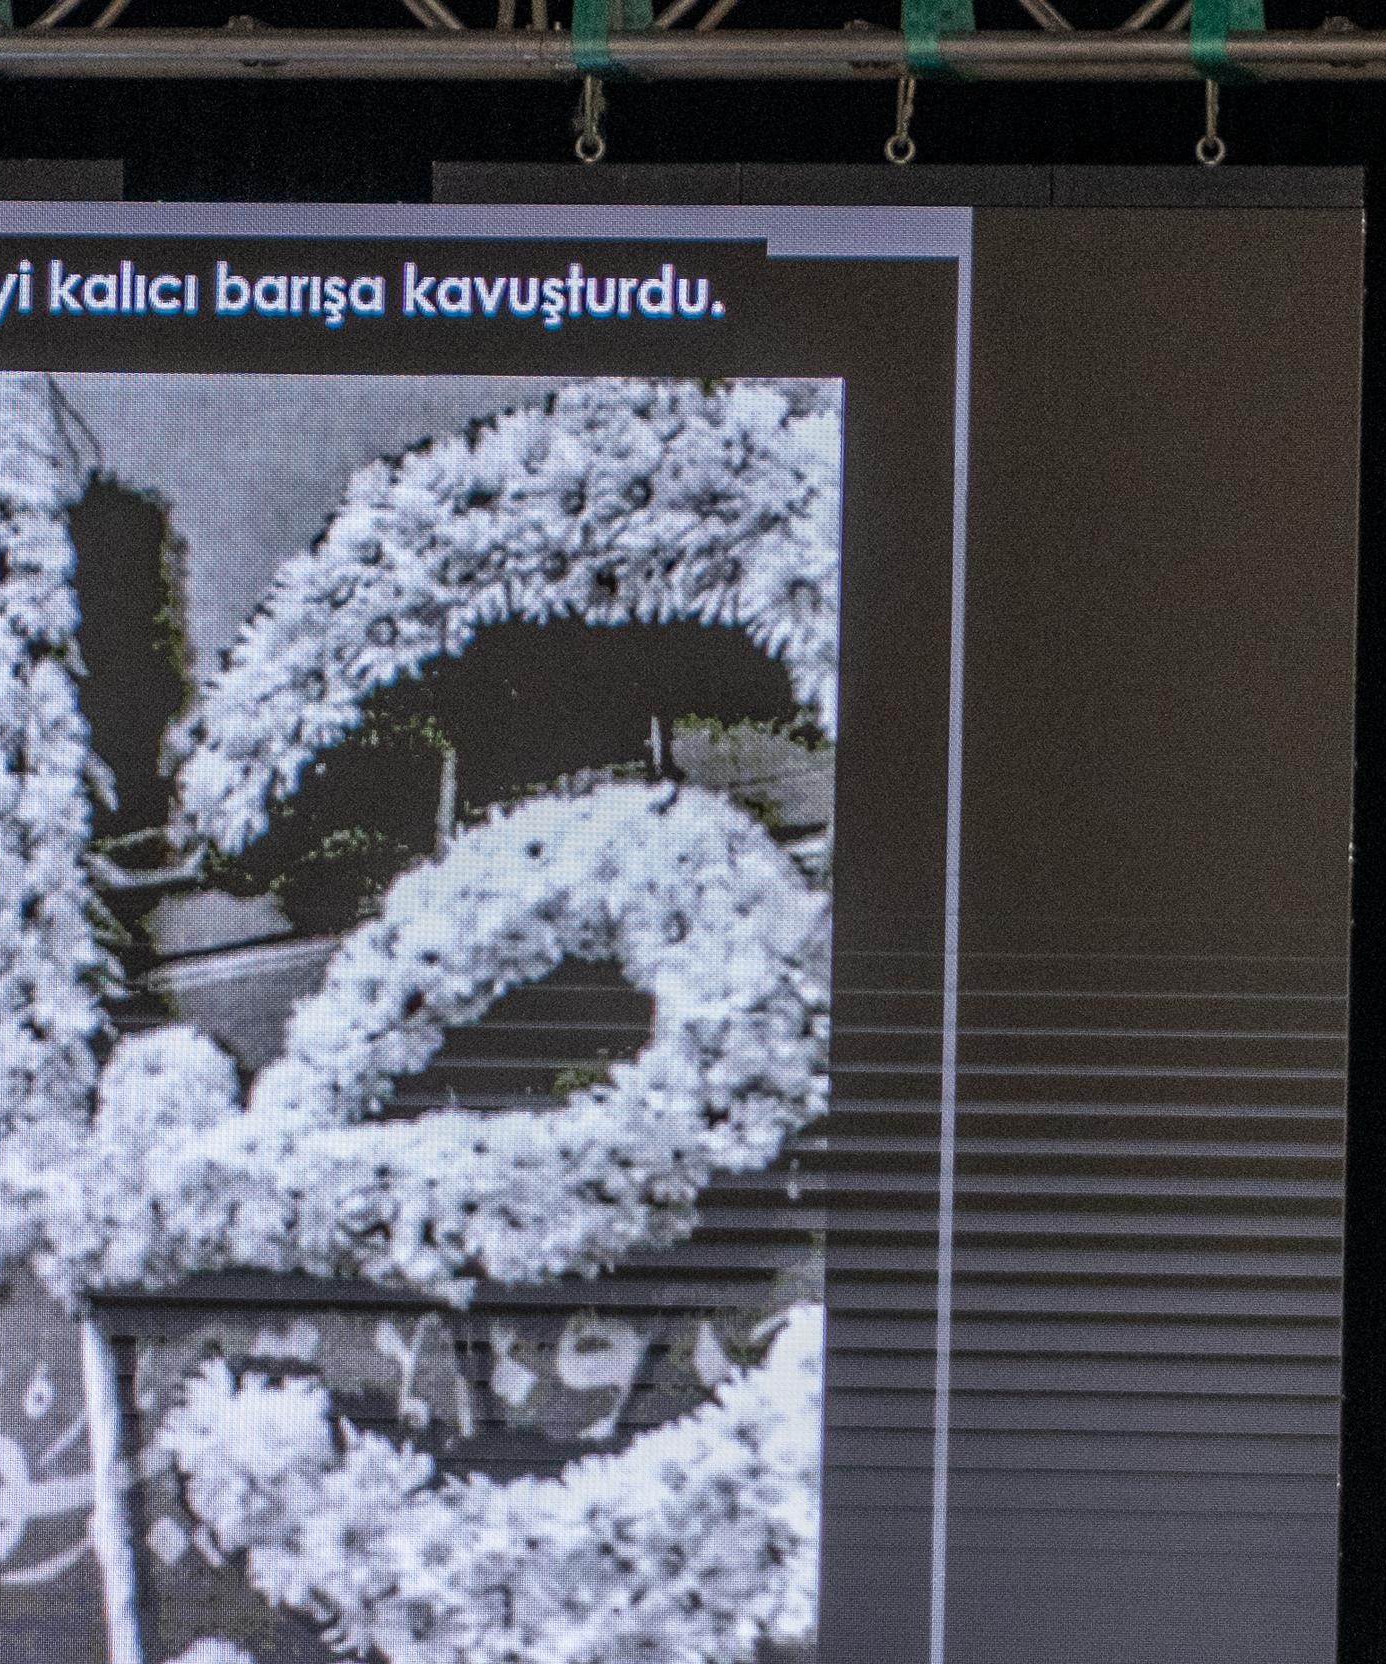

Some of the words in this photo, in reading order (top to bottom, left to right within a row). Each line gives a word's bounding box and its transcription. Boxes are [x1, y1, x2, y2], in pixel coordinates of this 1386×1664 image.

[47, 258, 200, 316] kalıcı
[214, 260, 386, 329] barışa
[401, 261, 727, 330] kavuşturdu.
